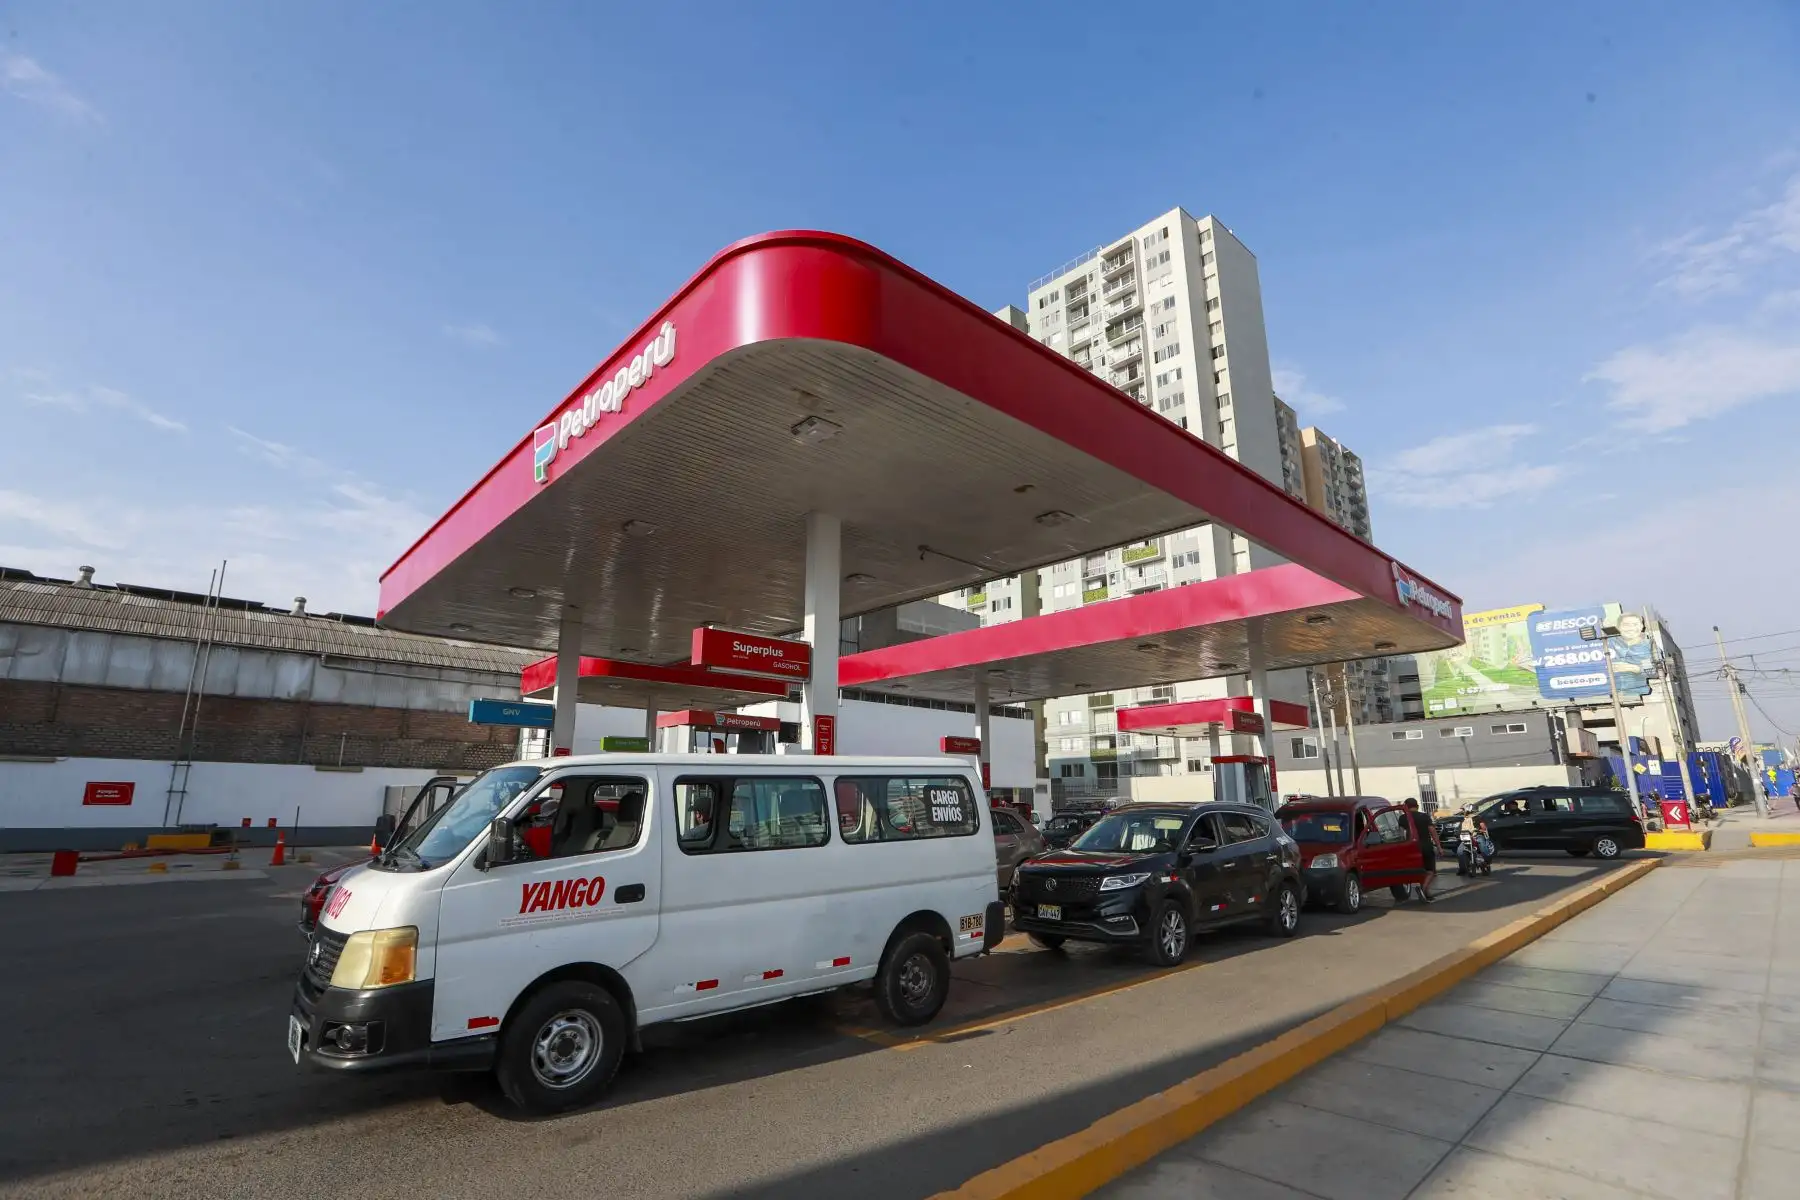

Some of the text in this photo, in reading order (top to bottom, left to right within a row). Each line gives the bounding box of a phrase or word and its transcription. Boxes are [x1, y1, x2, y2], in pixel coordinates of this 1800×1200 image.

[558, 320, 677, 449] Petroperú
[1472, 616, 1484, 624] de
[1486, 611, 1521, 622] ventas
[1553, 614, 1598, 630] BESCO
[732, 640, 784, 658] Superplus
[772, 661, 803, 671] GASOHOL
[1556, 676, 1601, 687] besco.pe
[502, 708, 521, 717] GNV
[930, 789, 959, 805] CARGO
[518, 875, 606, 915] YANGO
